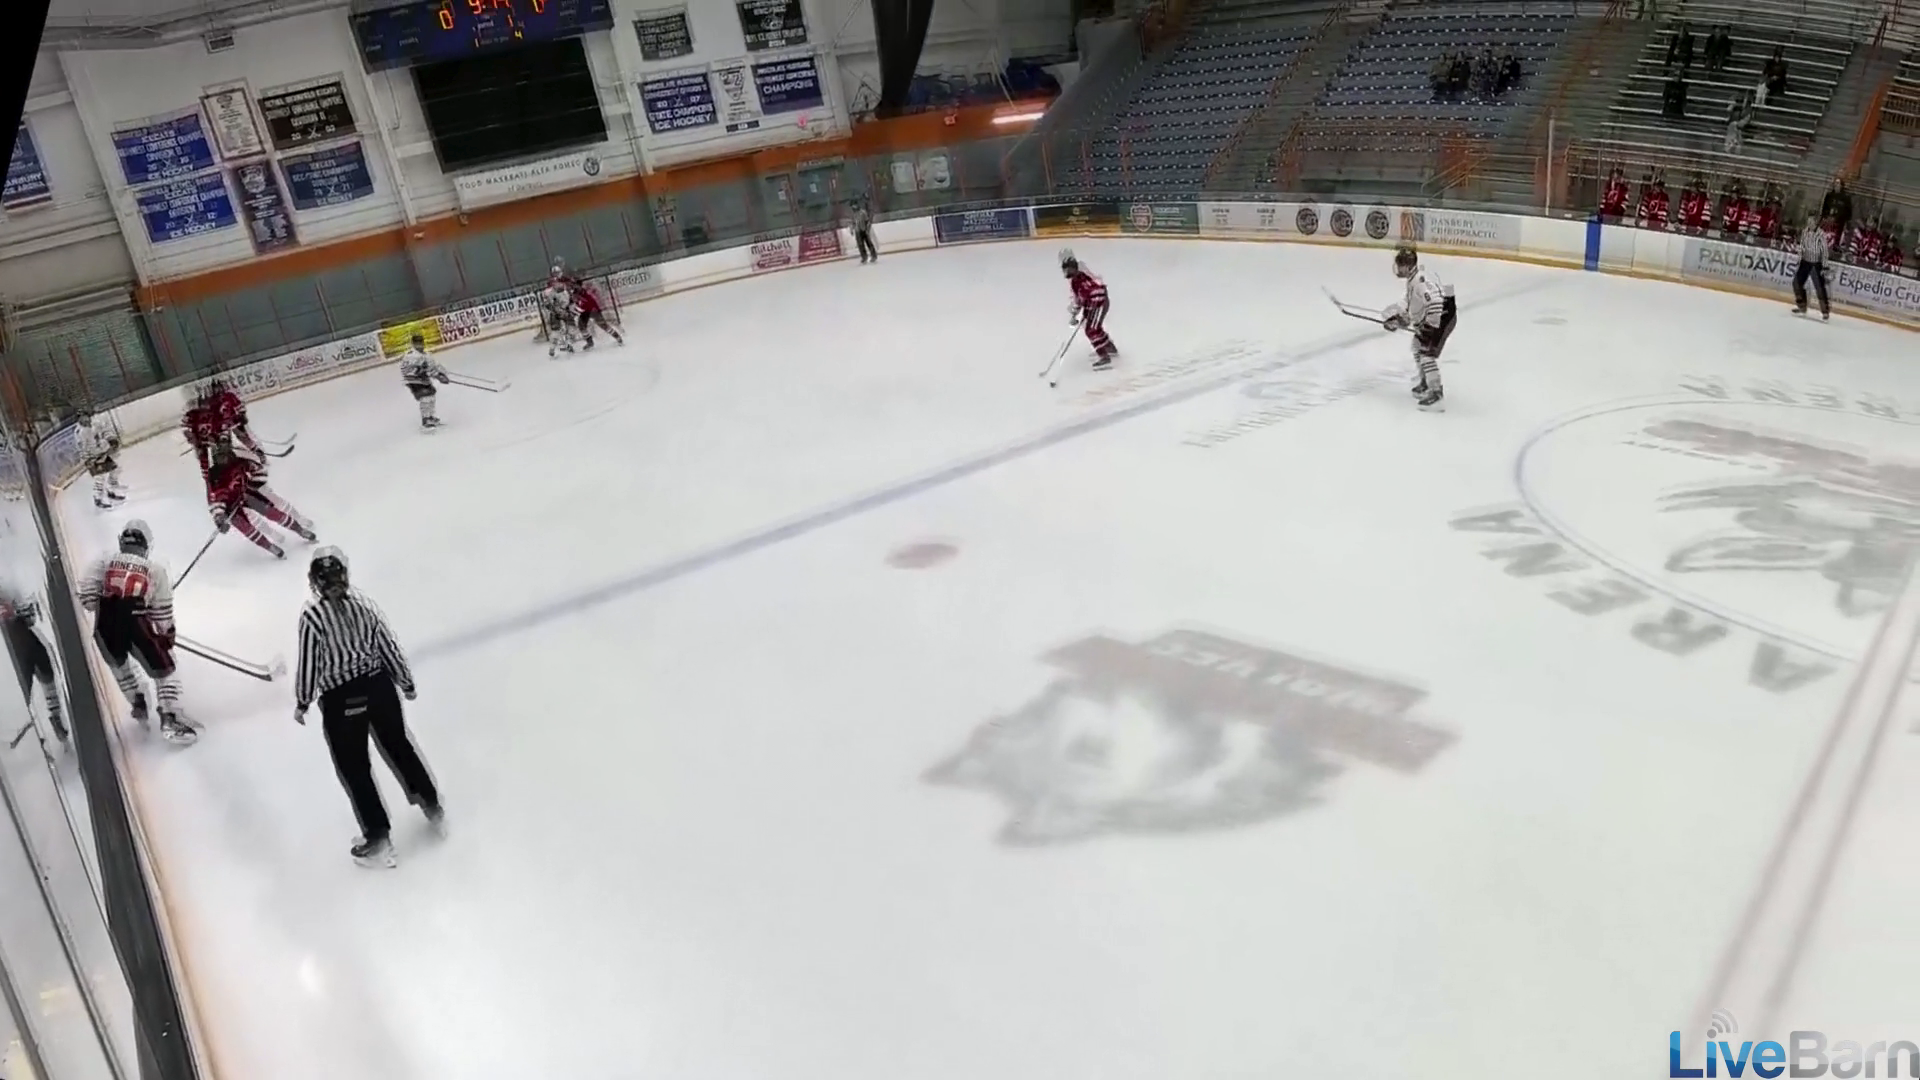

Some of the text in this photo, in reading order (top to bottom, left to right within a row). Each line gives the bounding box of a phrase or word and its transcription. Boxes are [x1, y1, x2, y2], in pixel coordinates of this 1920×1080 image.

[439, 9, 454, 29] 0
[654, 113, 711, 130] ICE HOCKEY
[4, 171, 42, 188] ANBURY
[479, 300, 515, 318] BUZAID
[110, 559, 150, 575] ARNESON
[103, 568, 150, 598] 50
